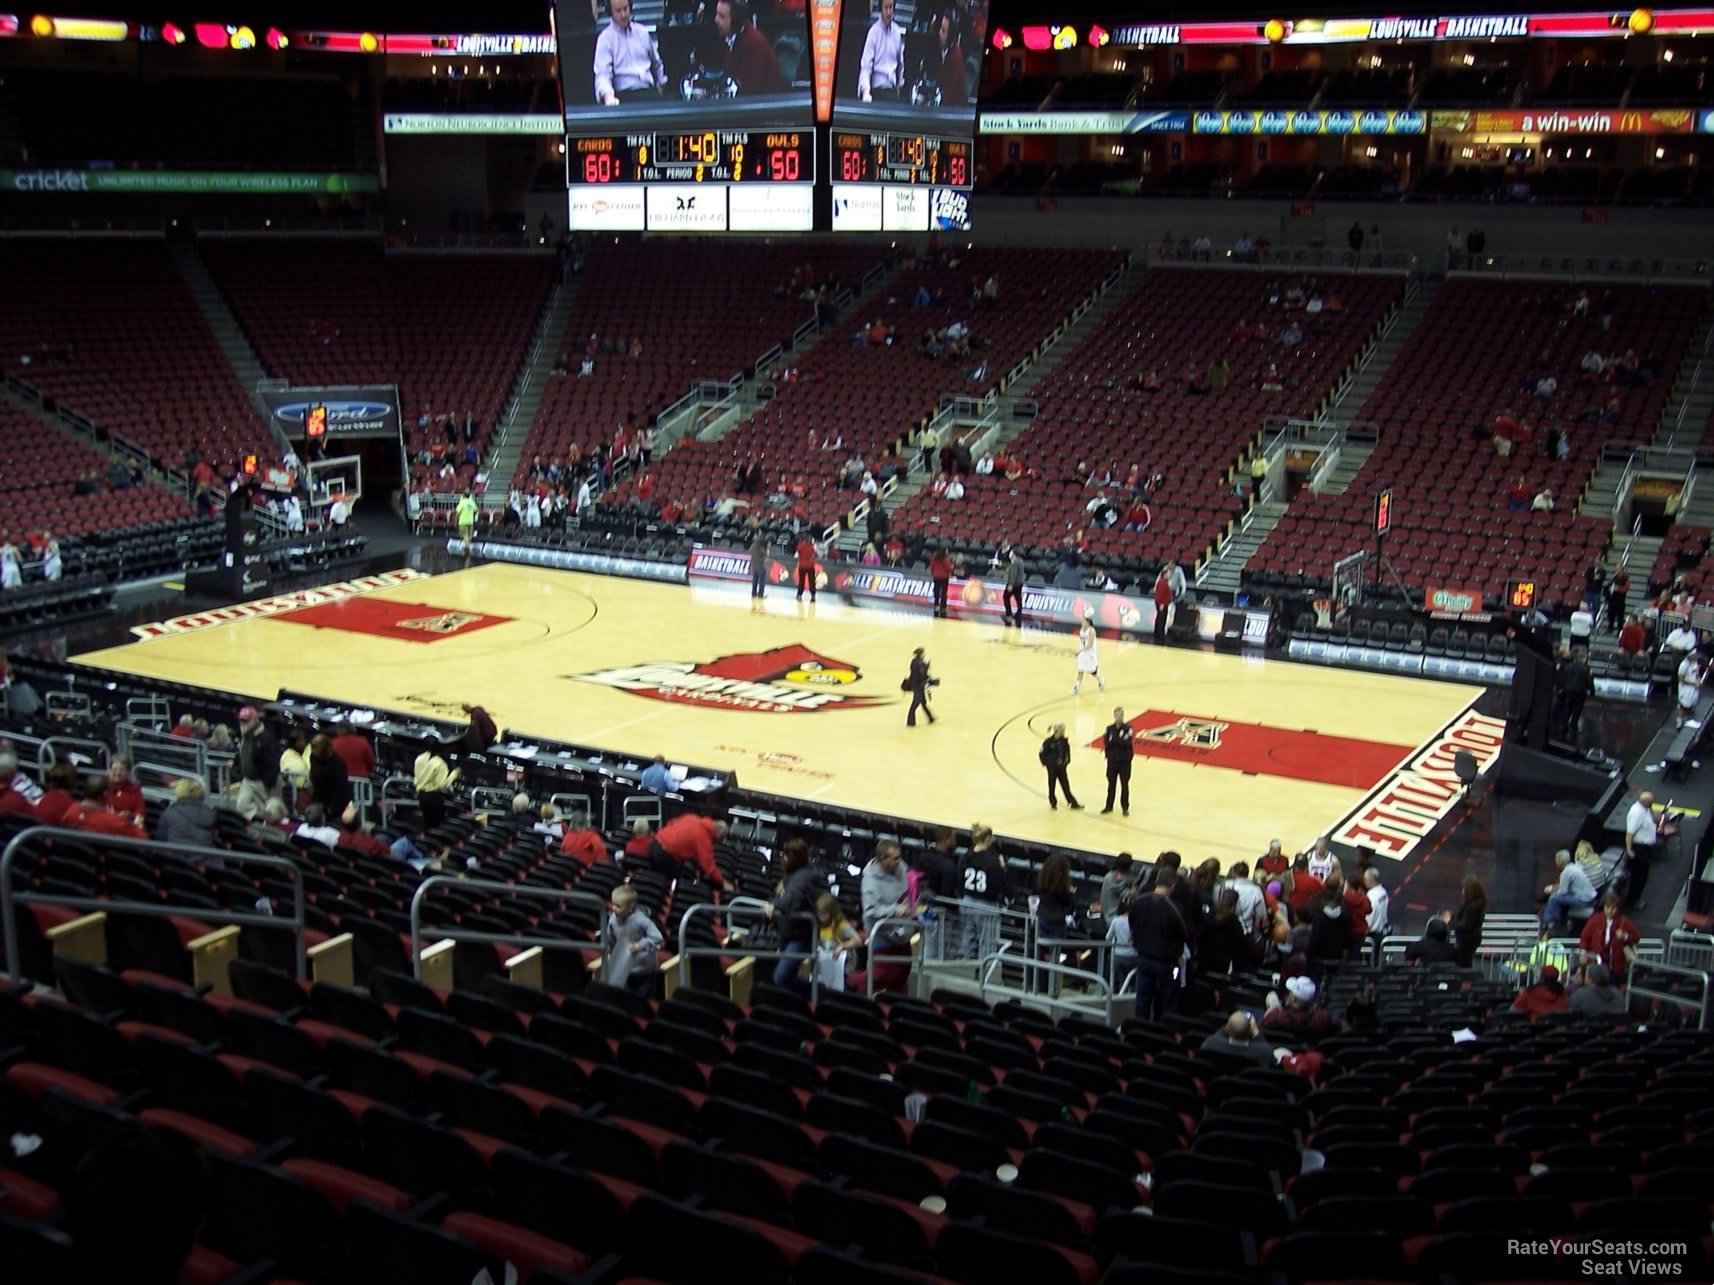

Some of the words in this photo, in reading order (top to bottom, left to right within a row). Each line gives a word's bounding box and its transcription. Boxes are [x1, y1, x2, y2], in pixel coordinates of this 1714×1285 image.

[1369, 18, 1437, 39] LOUISVILLE
[1446, 16, 1528, 37] BASKETBALL
[456, 34, 514, 51] LOUISVILLE
[983, 116, 1014, 130] Stock
[1017, 116, 1048, 130] Yards
[1521, 114, 1533, 132] a
[1537, 112, 1611, 132] win-win
[578, 138, 612, 152] CARDS
[766, 134, 799, 148] OWLS
[585, 153, 611, 183] 60
[666, 167, 693, 180] PERIOD
[771, 150, 799, 181] 50
[843, 151, 861, 181] 60
[951, 157, 966, 185] 50
[15, 170, 89, 191] cricket
[240, 176, 289, 187] WIRELESS
[291, 177, 318, 188] PLAN
[940, 188, 968, 212] BUD
[936, 202, 968, 224] LIGHT
[694, 554, 750, 576] BASKETBALL
[964, 867, 987, 893] 23
